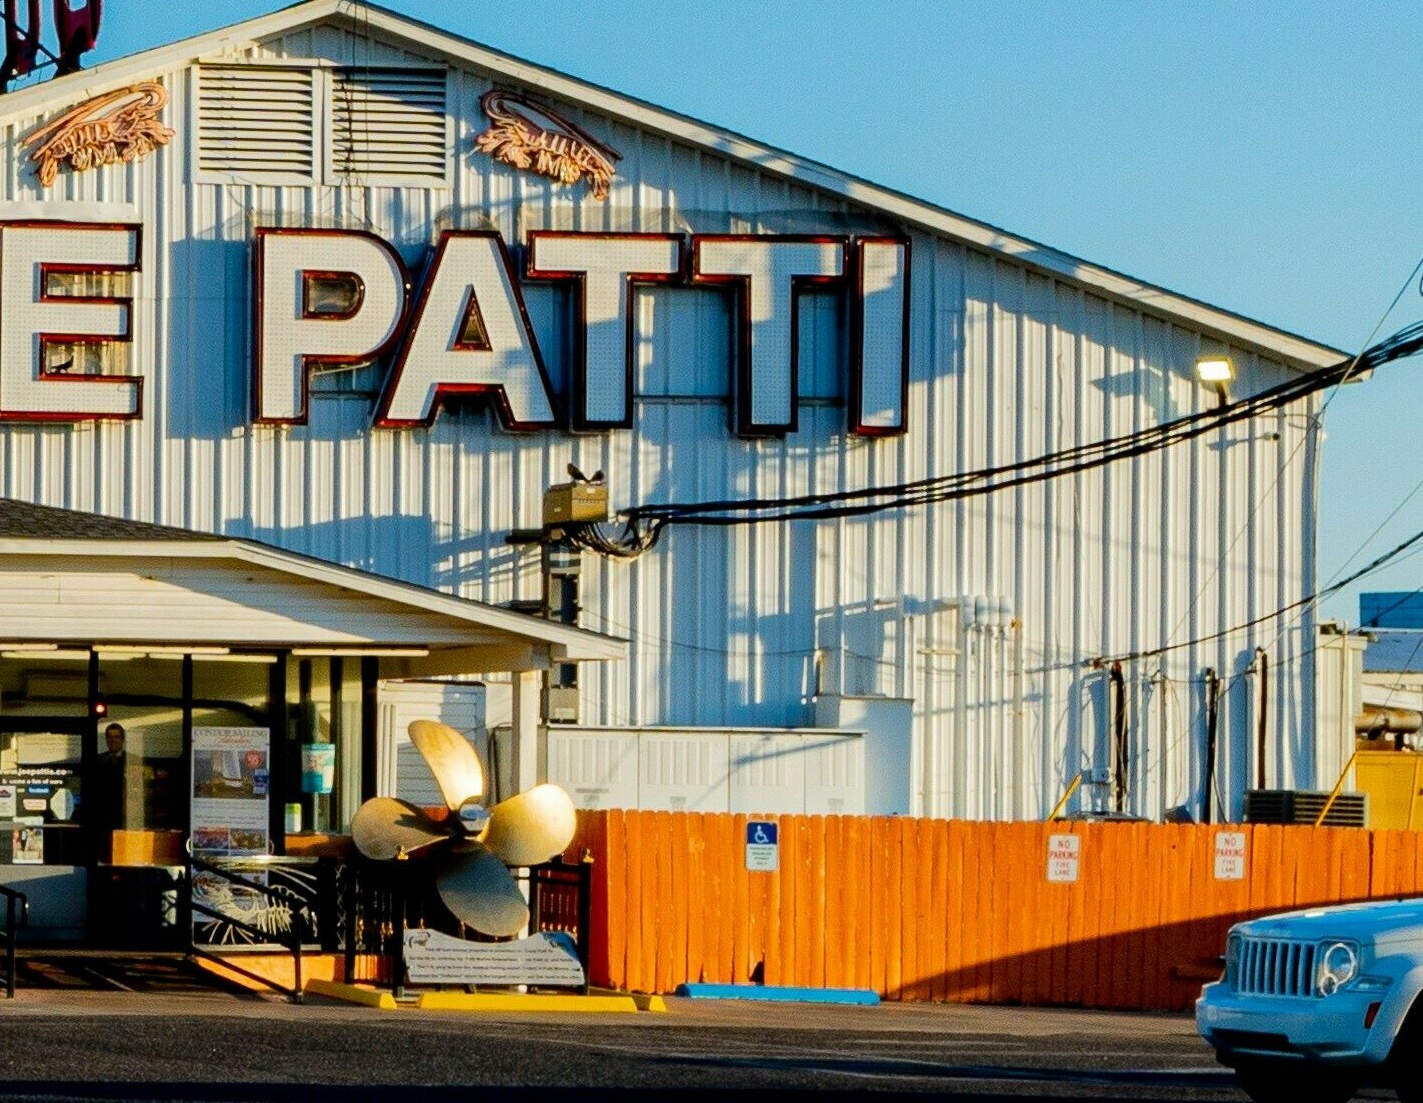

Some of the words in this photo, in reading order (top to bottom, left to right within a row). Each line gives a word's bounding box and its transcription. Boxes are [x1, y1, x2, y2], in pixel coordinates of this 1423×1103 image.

[251, 226, 912, 435] PATTI
[1058, 840, 1070, 848] NO
[1224, 838, 1236, 846] NO
[1050, 850, 1078, 860] PARKING
[1216, 848, 1244, 857] PARKING
